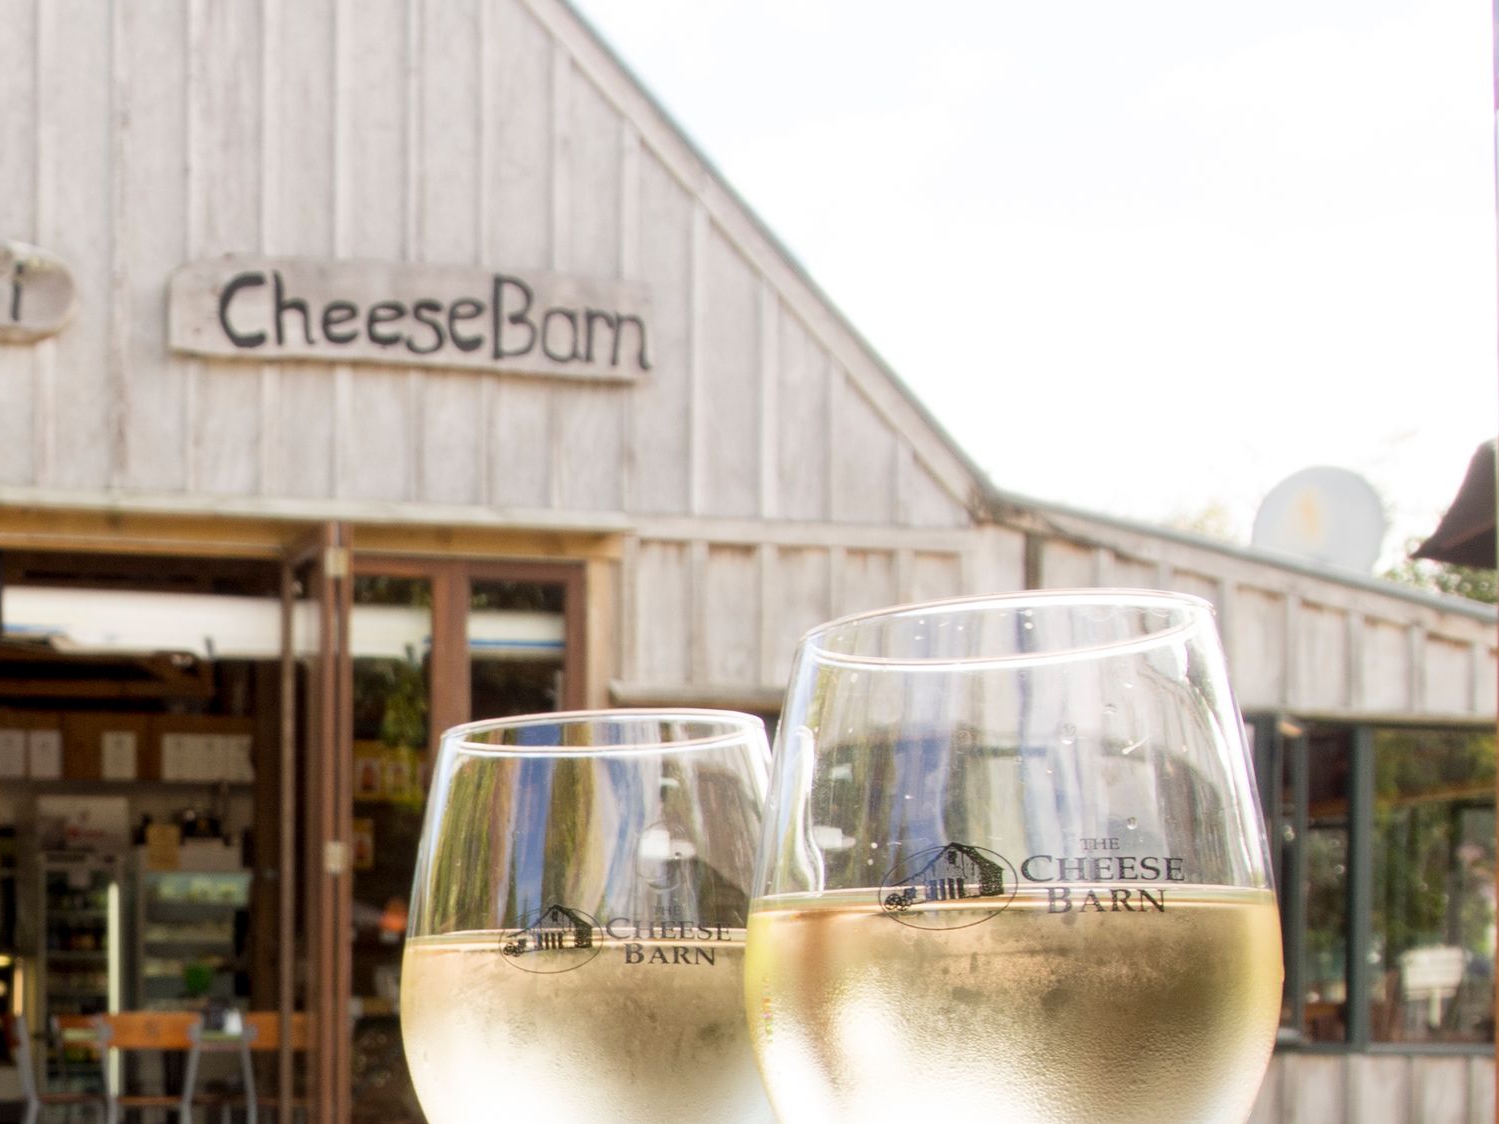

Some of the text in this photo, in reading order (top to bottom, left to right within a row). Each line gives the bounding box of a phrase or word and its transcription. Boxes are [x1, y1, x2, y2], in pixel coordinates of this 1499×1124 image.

[1079, 837, 1121, 851] THE
[1020, 854, 1186, 882] CHEESE
[1045, 886, 1166, 914] BARN
[605, 917, 732, 942] CHEESE
[624, 943, 716, 966] BARN
